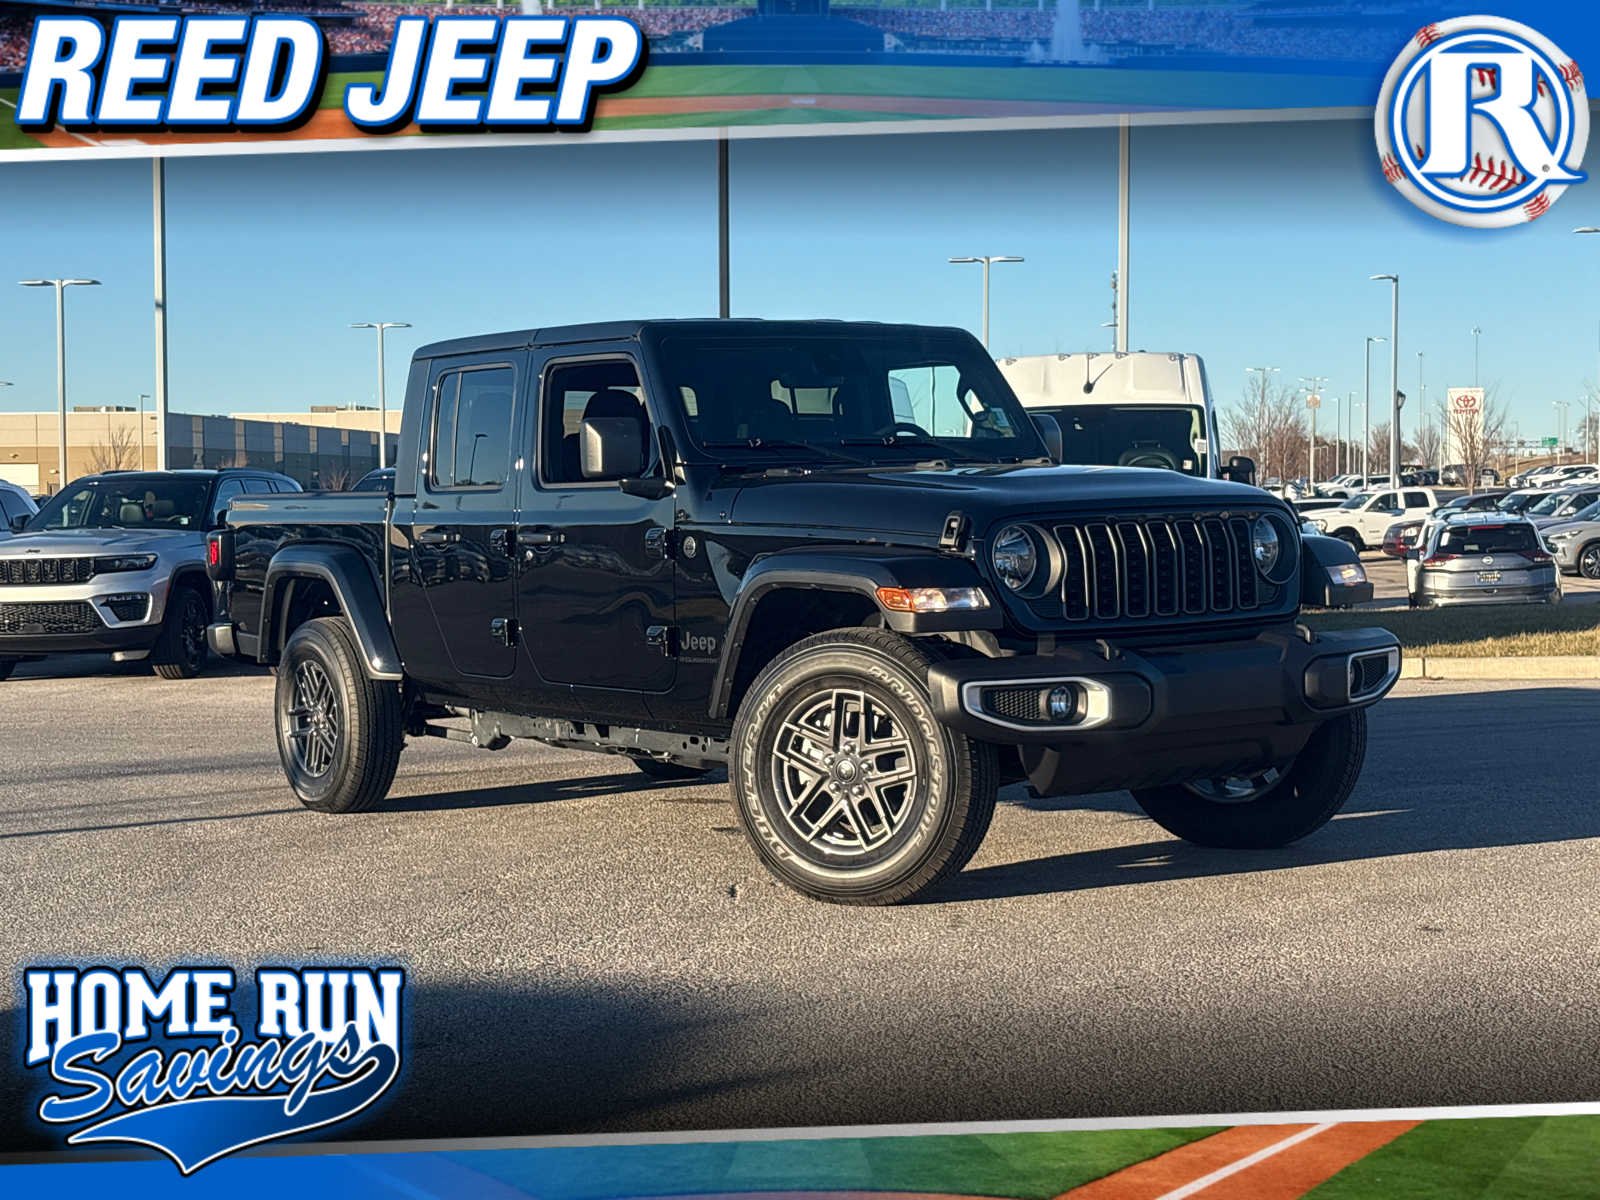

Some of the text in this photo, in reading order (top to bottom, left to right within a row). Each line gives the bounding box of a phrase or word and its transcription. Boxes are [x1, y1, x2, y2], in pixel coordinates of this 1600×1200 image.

[680, 631, 717, 655] Jeep
[742, 723, 791, 861] DUELER
[868, 665, 944, 846] BRIDGESTONE
